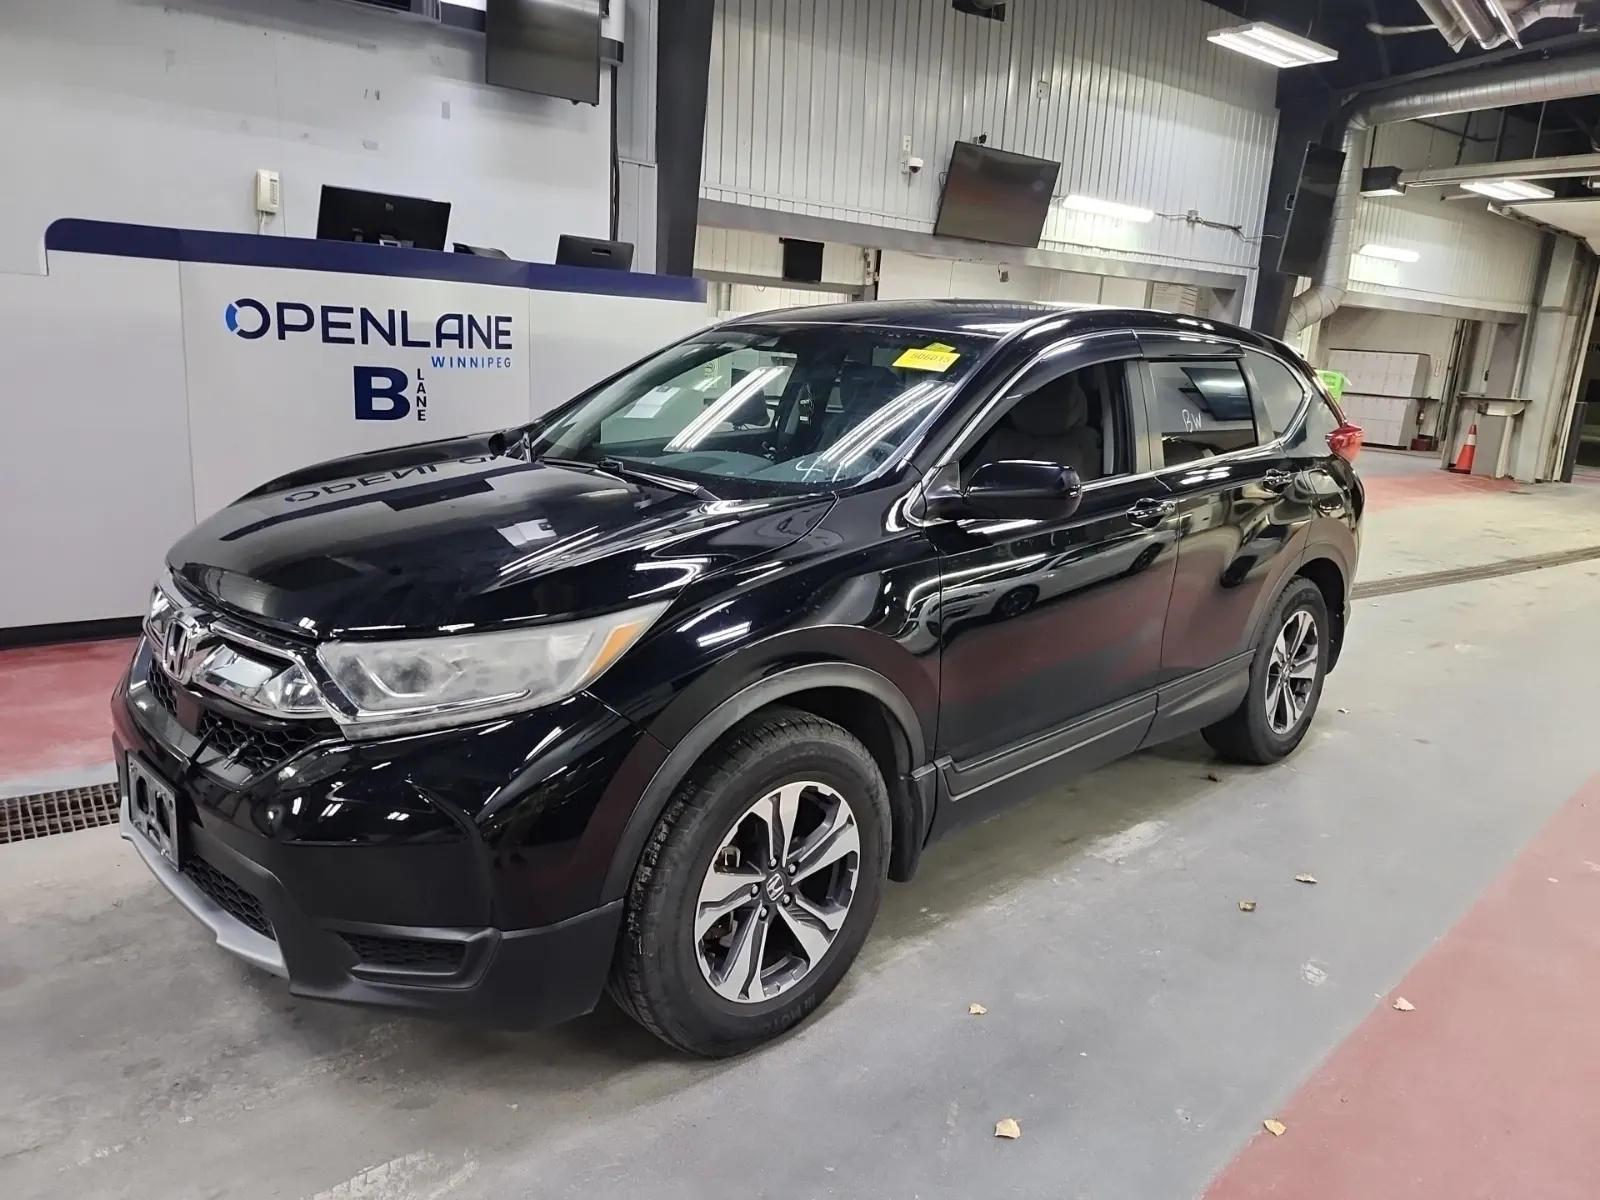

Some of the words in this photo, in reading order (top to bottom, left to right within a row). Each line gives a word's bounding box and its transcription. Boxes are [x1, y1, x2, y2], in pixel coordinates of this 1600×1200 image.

[225, 298, 513, 349] OPENLANE
[431, 356, 511, 368] WINNIPEG
[353, 365, 411, 420] B
[416, 368, 428, 421] LANE
